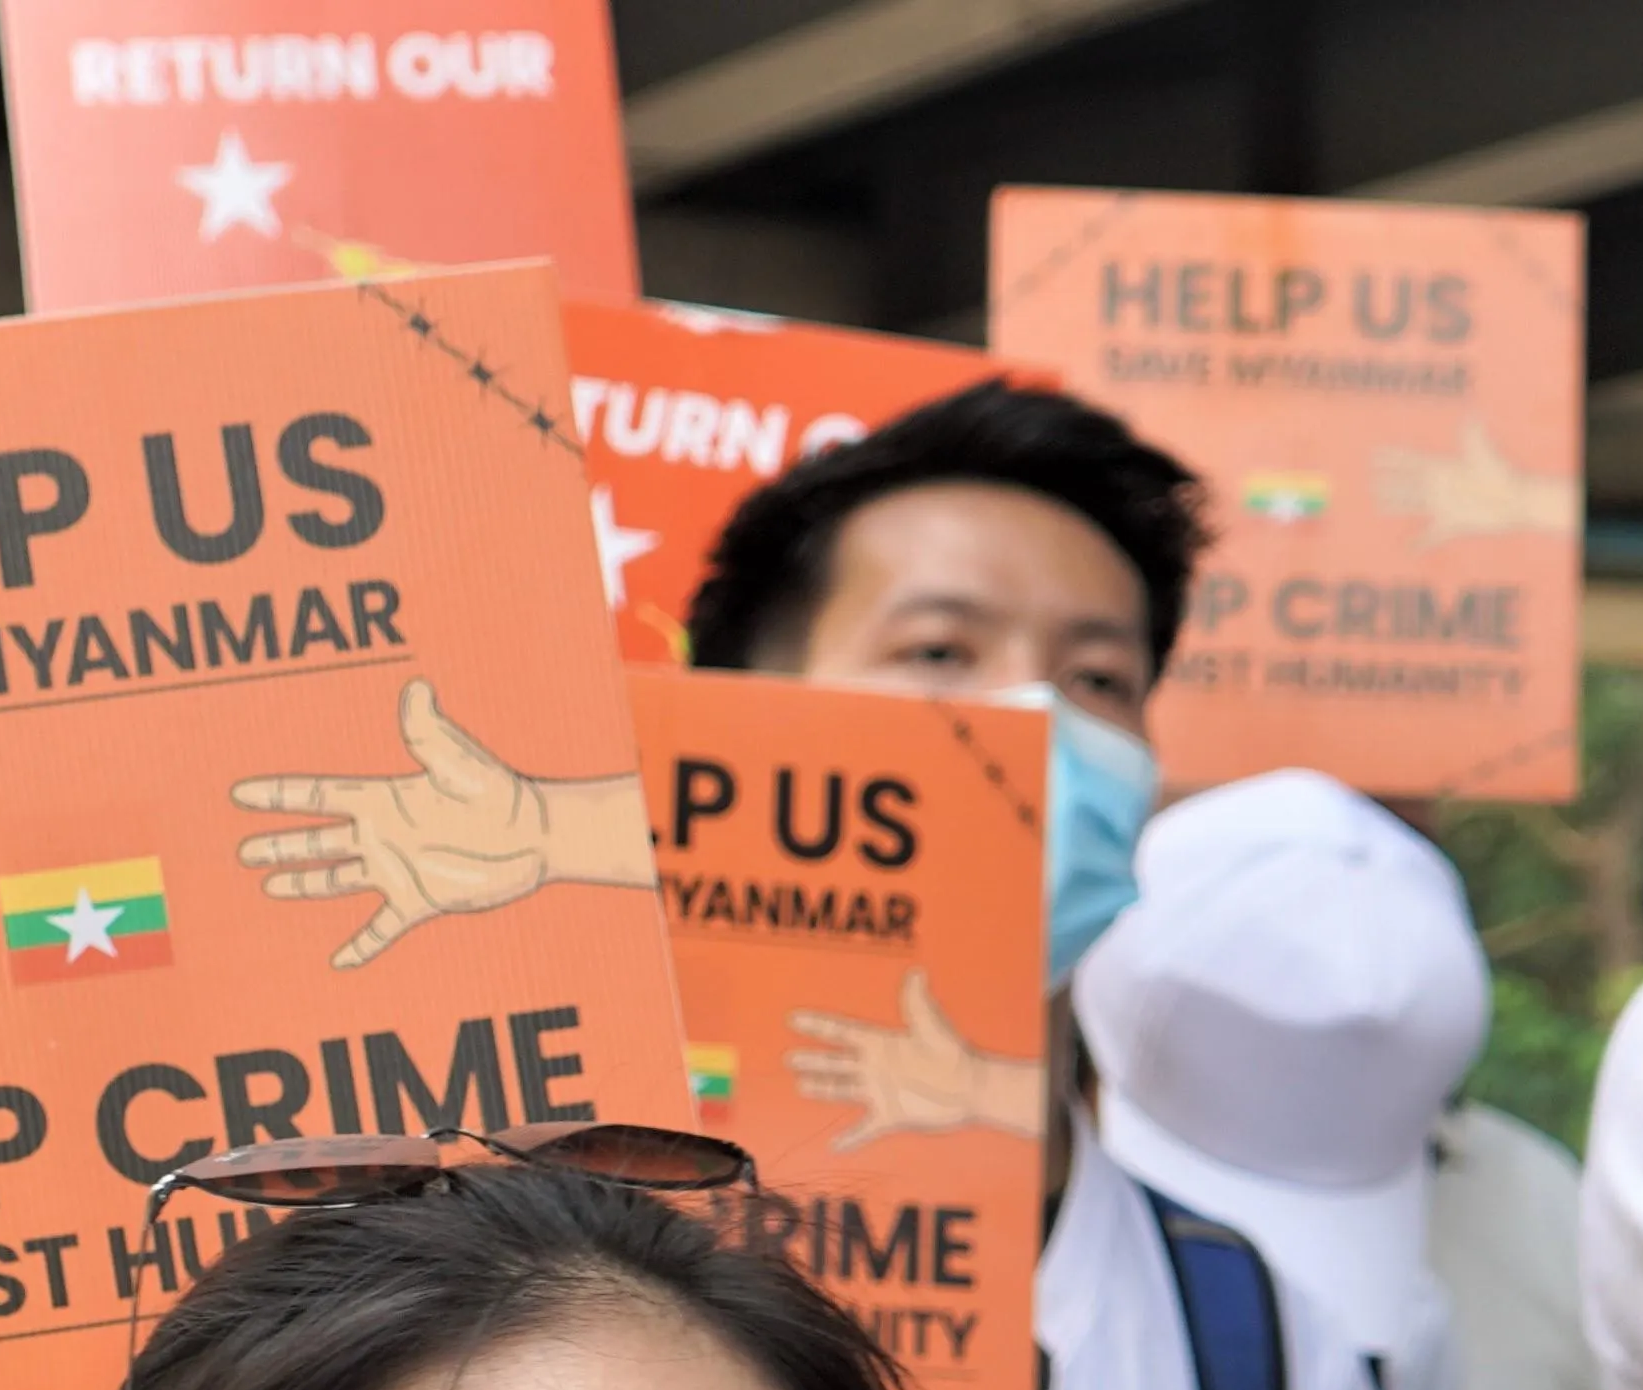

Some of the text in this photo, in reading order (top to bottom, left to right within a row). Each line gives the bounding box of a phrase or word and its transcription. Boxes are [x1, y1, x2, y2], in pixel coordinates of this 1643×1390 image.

[72, 30, 555, 105] RETURN OUR
[1099, 260, 1474, 346] HELP US
[142, 411, 387, 566] US
[1273, 578, 1520, 646] CRIME
[775, 765, 919, 870] US
[660, 872, 919, 940] YANMAR
[95, 1007, 596, 1192] CRIME
